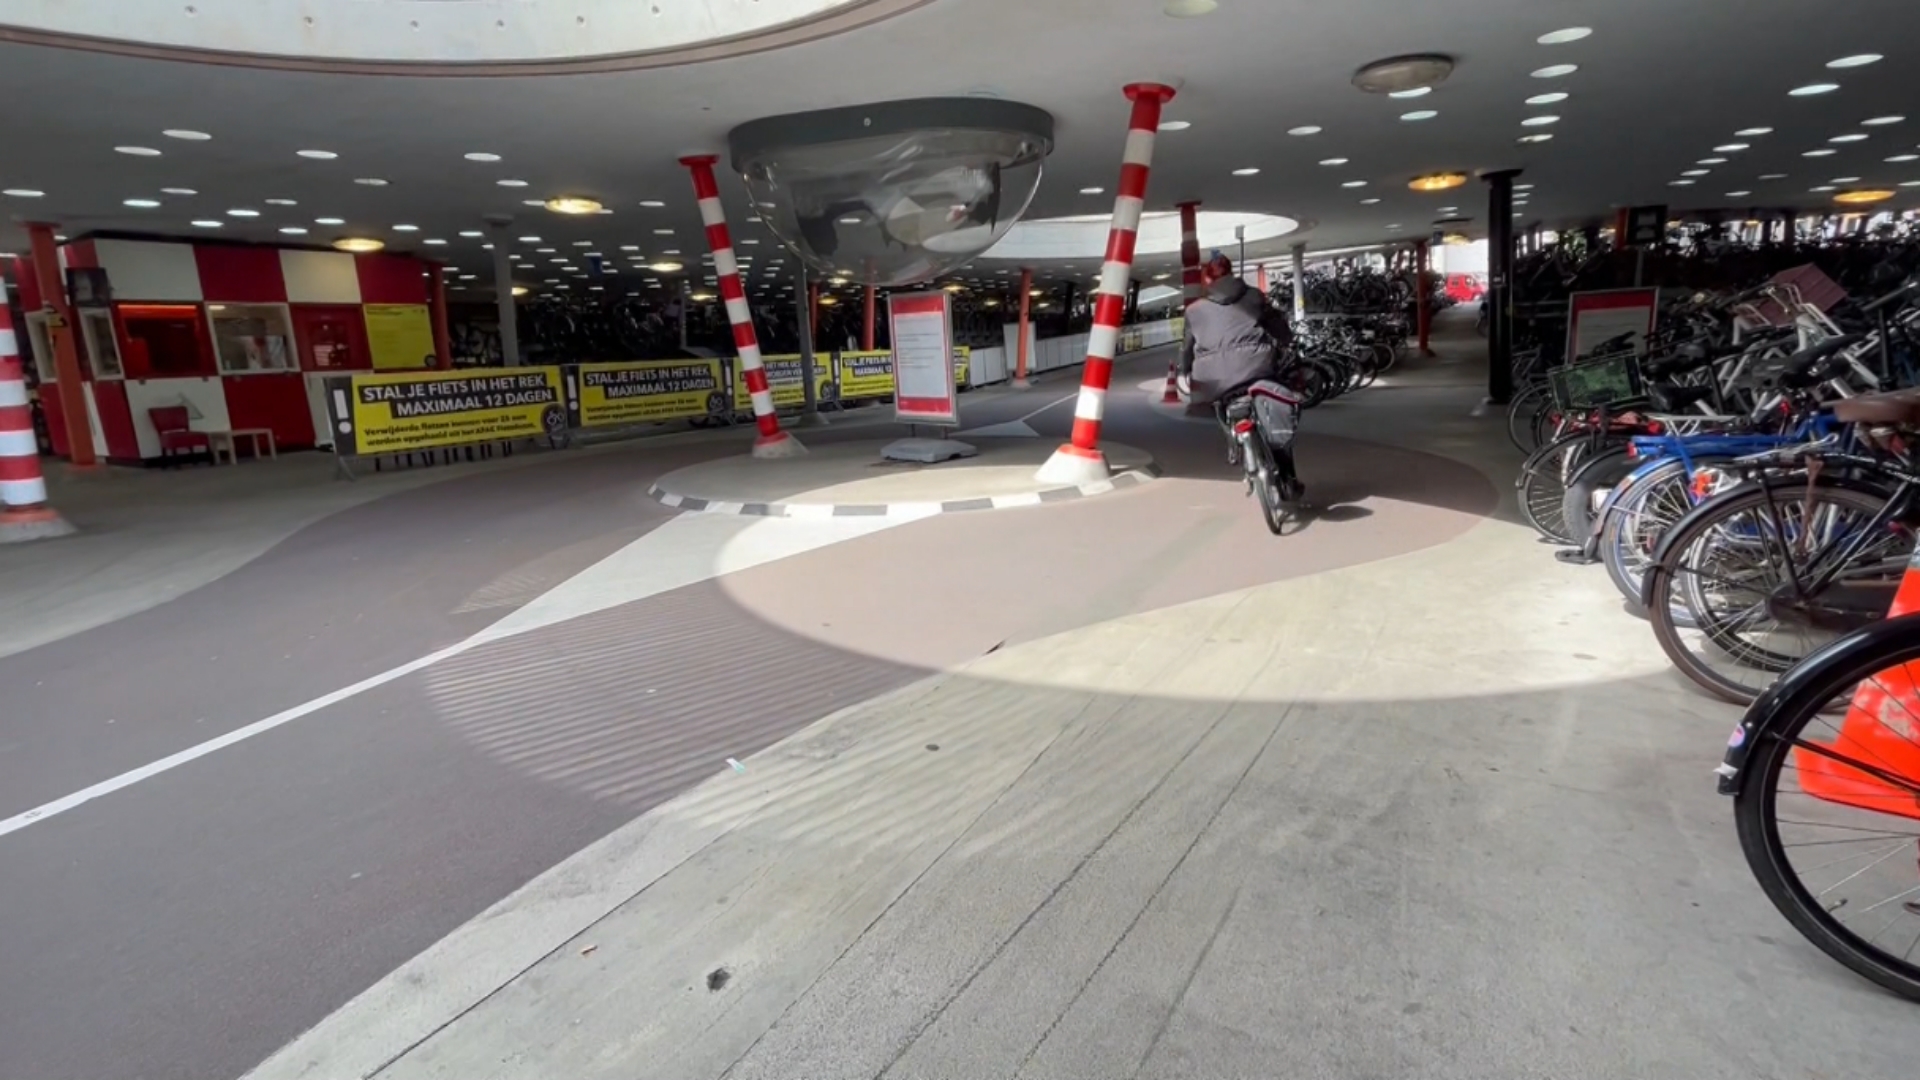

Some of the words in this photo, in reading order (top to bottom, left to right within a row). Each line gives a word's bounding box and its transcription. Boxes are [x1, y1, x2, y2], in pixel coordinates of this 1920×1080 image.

[363, 385, 405, 401] STAL
[407, 383, 426, 398] JE
[428, 380, 469, 396] FIETS
[470, 379, 487, 392] IN
[489, 377, 516, 390] HET
[518, 374, 545, 387] REK
[585, 372, 613, 385] STAL
[615, 371, 628, 383] JE
[629, 369, 657, 382] FIETS
[658, 368, 670, 379] IN
[671, 367, 690, 378] HET
[607, 383, 666, 398] MAXIMAAL
[668, 382, 680, 392] 12
[681, 378, 715, 391] DAGEN
[396, 395, 483, 416] MAXIMAAL
[485, 394, 504, 407] 12
[505, 389, 552, 405] DAGEN
